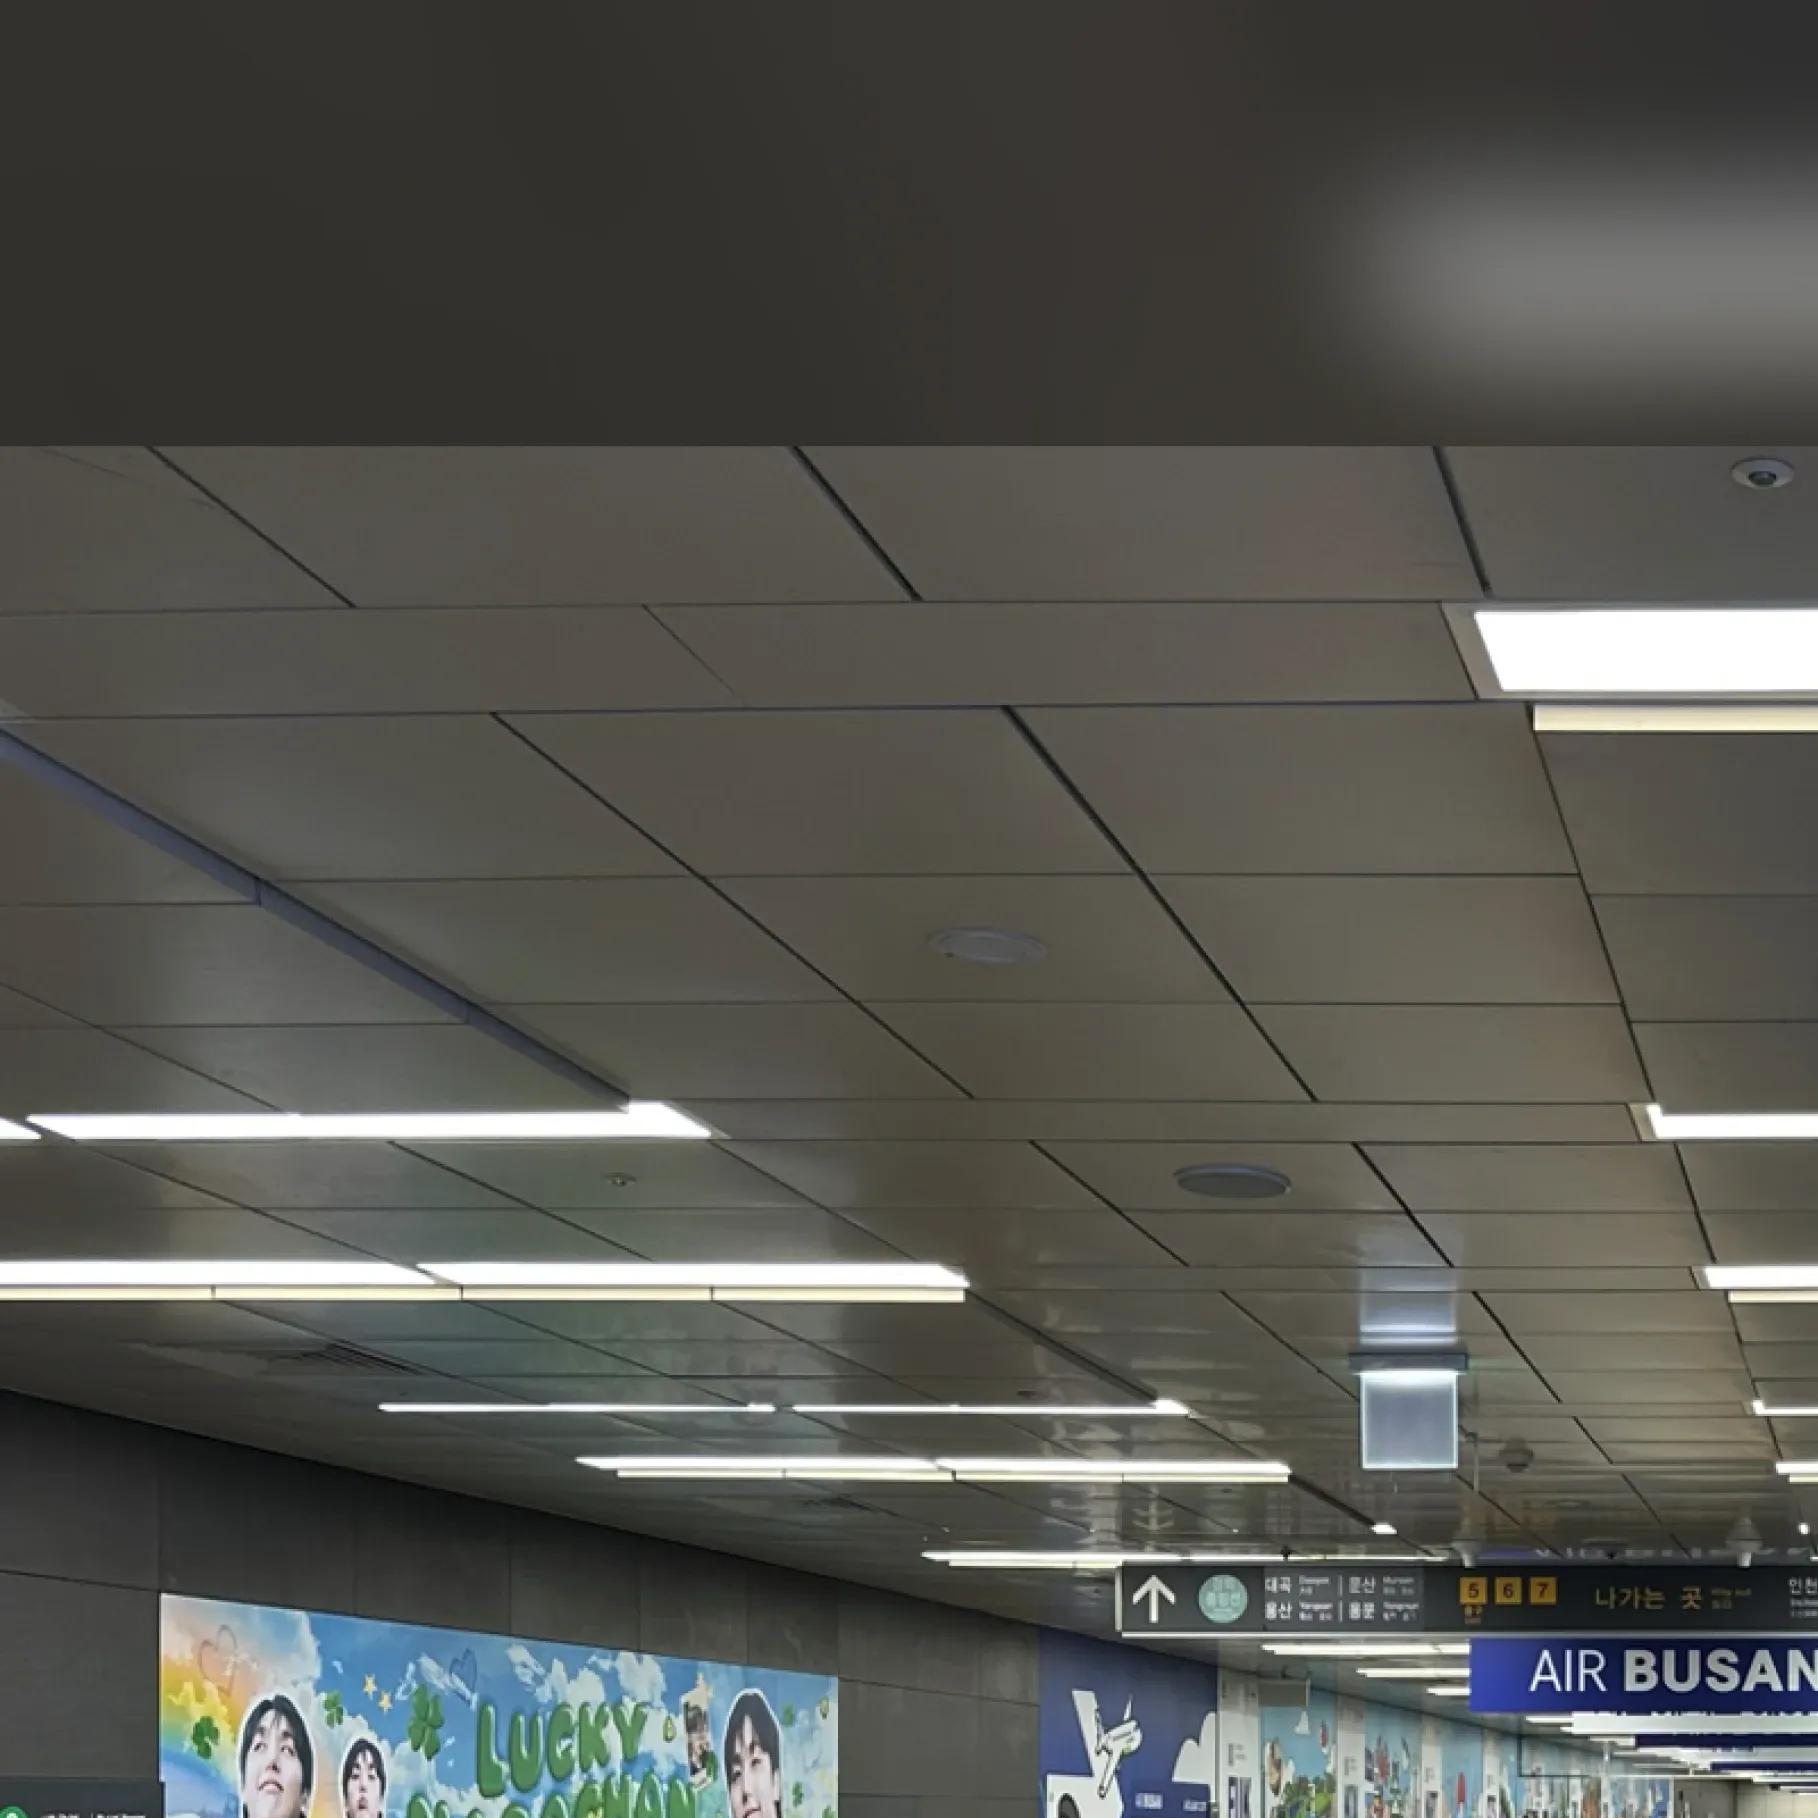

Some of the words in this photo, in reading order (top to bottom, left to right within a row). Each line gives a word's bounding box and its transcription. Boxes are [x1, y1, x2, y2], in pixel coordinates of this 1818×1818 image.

[1595, 1585, 1666, 1610] 나가는
[1682, 1585, 1702, 1611] 곳
[1529, 1648, 1608, 1693] AIR
[476, 1701, 649, 1798] LUCKY
